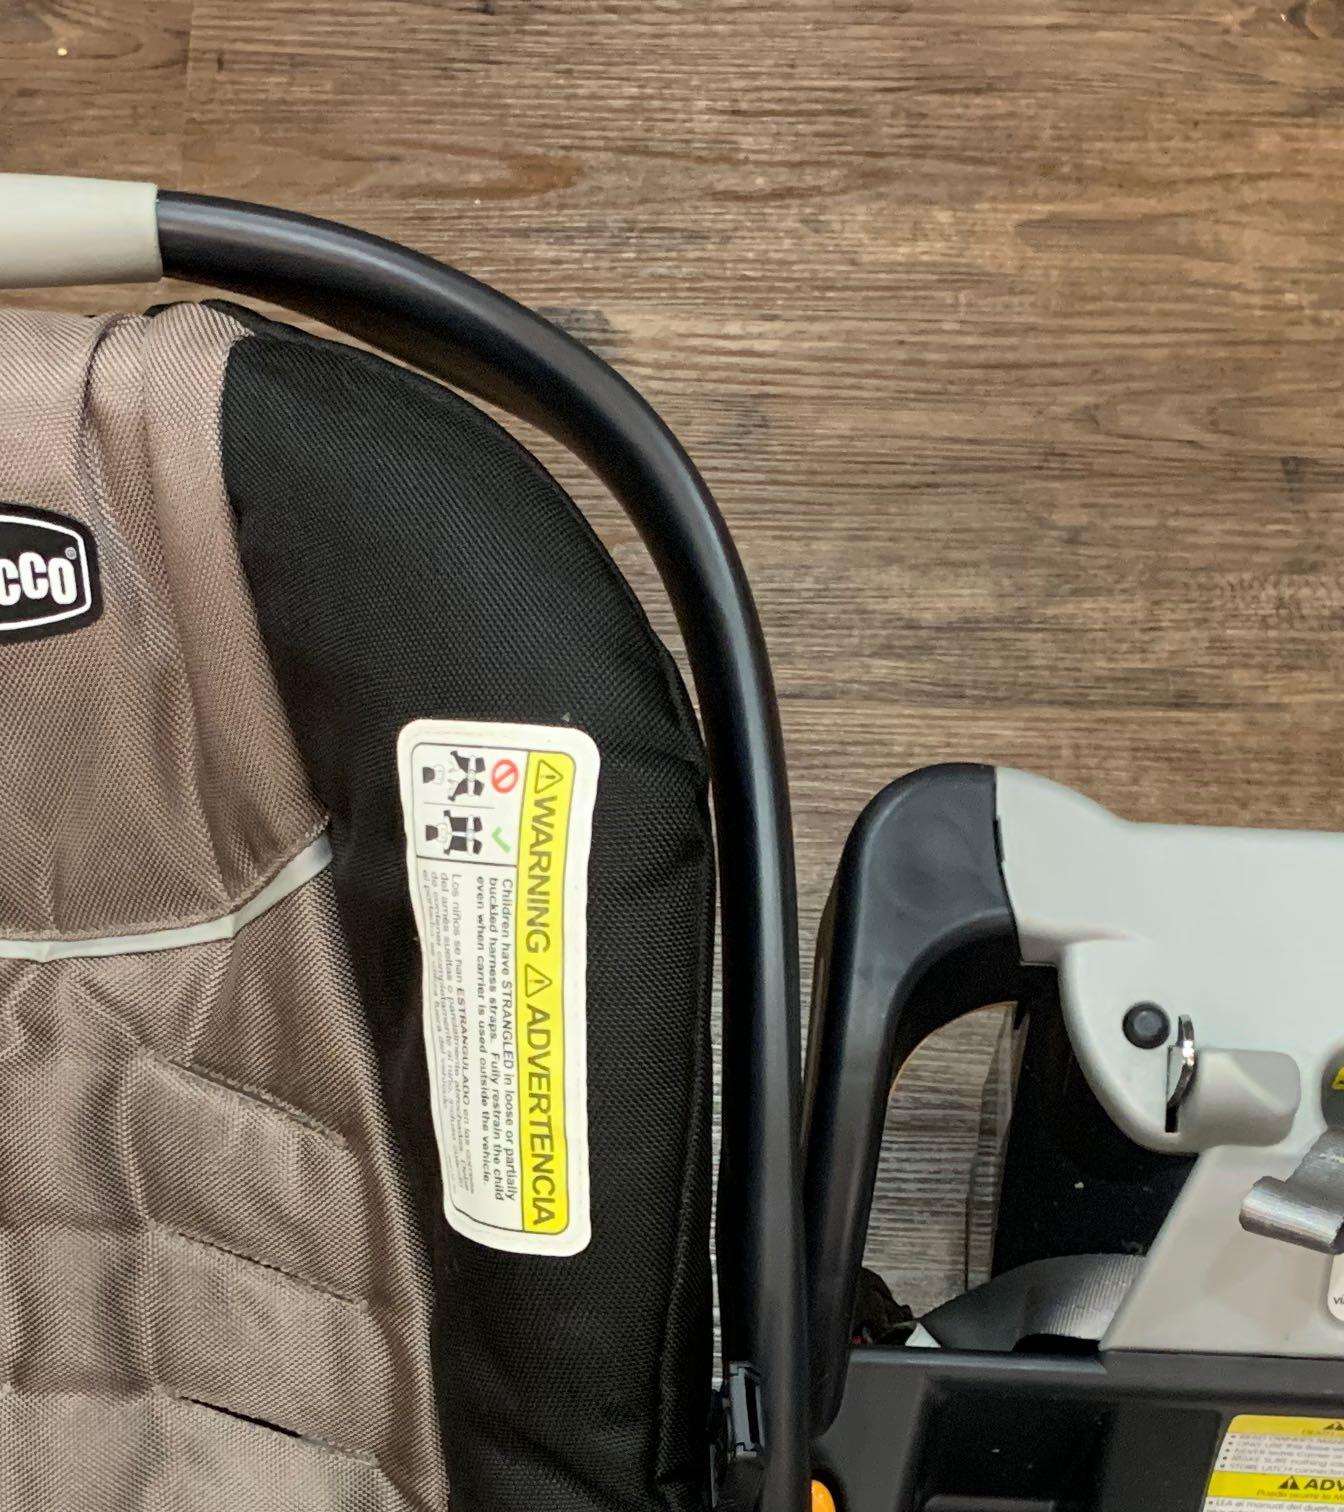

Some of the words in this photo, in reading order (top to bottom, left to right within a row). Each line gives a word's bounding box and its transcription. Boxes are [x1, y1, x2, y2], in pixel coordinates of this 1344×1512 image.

[475, 876, 484, 909] even
[523, 794, 557, 955] WARNING
[488, 877, 499, 932] buckled
[500, 878, 513, 938] Children
[475, 914, 485, 950] when
[476, 955, 486, 998] carrier
[487, 937, 498, 992] harness
[500, 942, 511, 975] have
[477, 1004, 486, 1015] is
[487, 997, 499, 1043] straps.
[500, 979, 514, 1068] STRANGLED
[478, 1020, 487, 1052] used
[479, 1057, 489, 1107] outside
[489, 1052, 500, 1084] Fully
[503, 1073, 514, 1085] in
[492, 1089, 502, 1139] restrain
[504, 1090, 514, 1126] loose
[526, 1003, 557, 1227] ADVERTENCIA
[492, 1143, 502, 1165] the
[505, 1130, 513, 1143] or
[481, 1136, 491, 1185] vehicle.
[503, 1148, 516, 1200] partially
[494, 1168, 503, 1200] child
